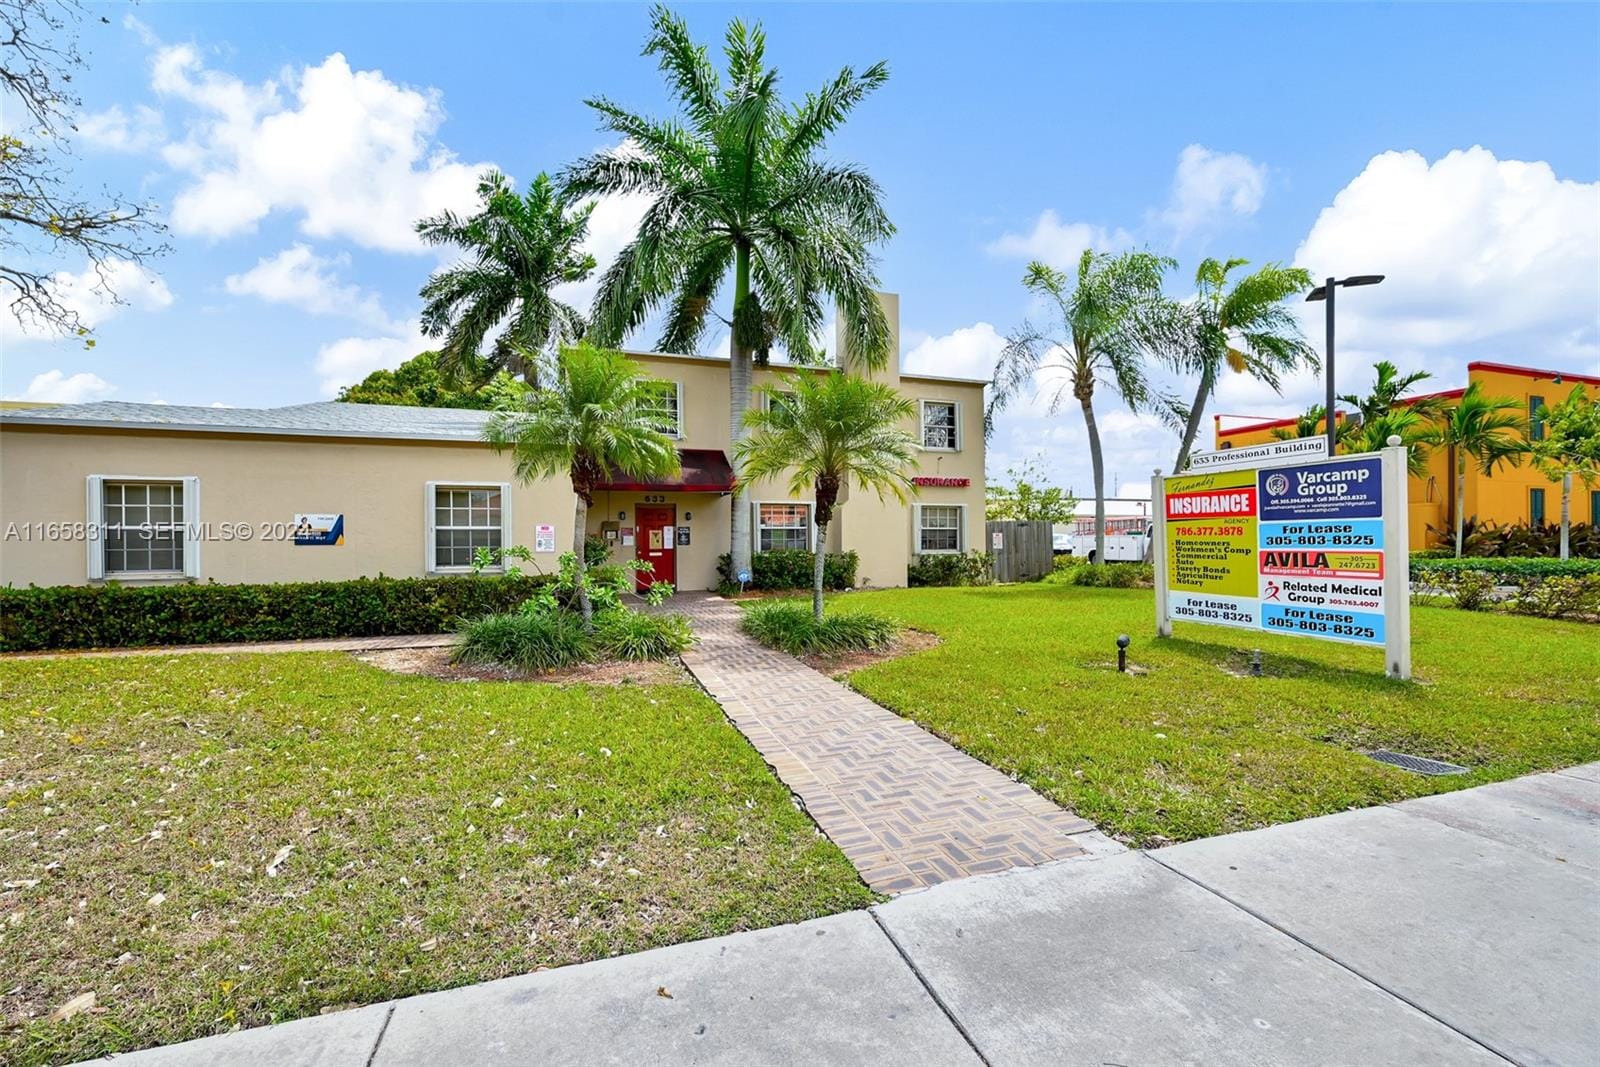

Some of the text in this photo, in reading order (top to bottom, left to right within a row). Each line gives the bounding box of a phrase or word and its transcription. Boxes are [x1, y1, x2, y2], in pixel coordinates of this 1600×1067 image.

[1194, 442, 1322, 465] 633 Professional Building
[1296, 468, 1370, 484] Varcamp
[1297, 483, 1348, 496] Group
[1170, 494, 1250, 514] INSURANCE
[1176, 526, 1243, 536] 786.377.3878
[1282, 525, 1352, 534] For Lease
[1266, 535, 1374, 546] 305-803-8325
[1224, 547, 1251, 555] Comp
[1264, 552, 1330, 568] AVILA
[1176, 572, 1224, 580] Agriculture
[1176, 578, 1203, 586] Notary
[1283, 581, 1382, 596] Related Medical
[1205, 600, 1237, 611] Lease
[1288, 592, 1379, 608] Group 305.763.4007
[1175, 606, 1253, 623] 305-803-8325
[1284, 608, 1353, 624] For Lease
[1268, 617, 1375, 638] 305-803-8325
